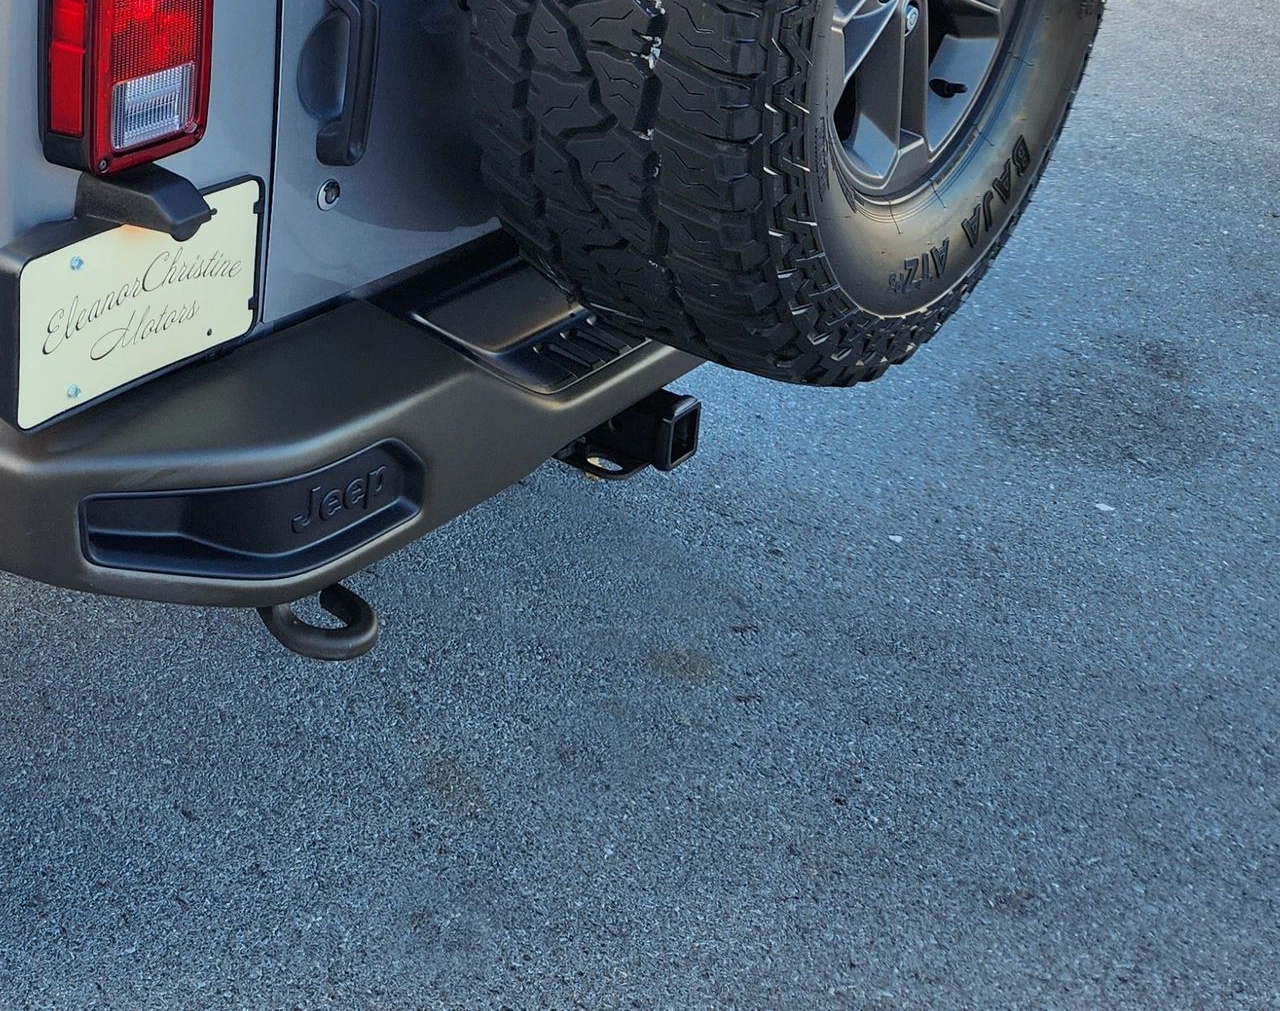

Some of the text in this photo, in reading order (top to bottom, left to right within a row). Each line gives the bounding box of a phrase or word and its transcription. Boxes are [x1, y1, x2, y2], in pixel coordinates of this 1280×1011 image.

[961, 134, 1031, 249] BAJA
[90, 300, 201, 361] Motors
[290, 465, 387, 534] Jeep
